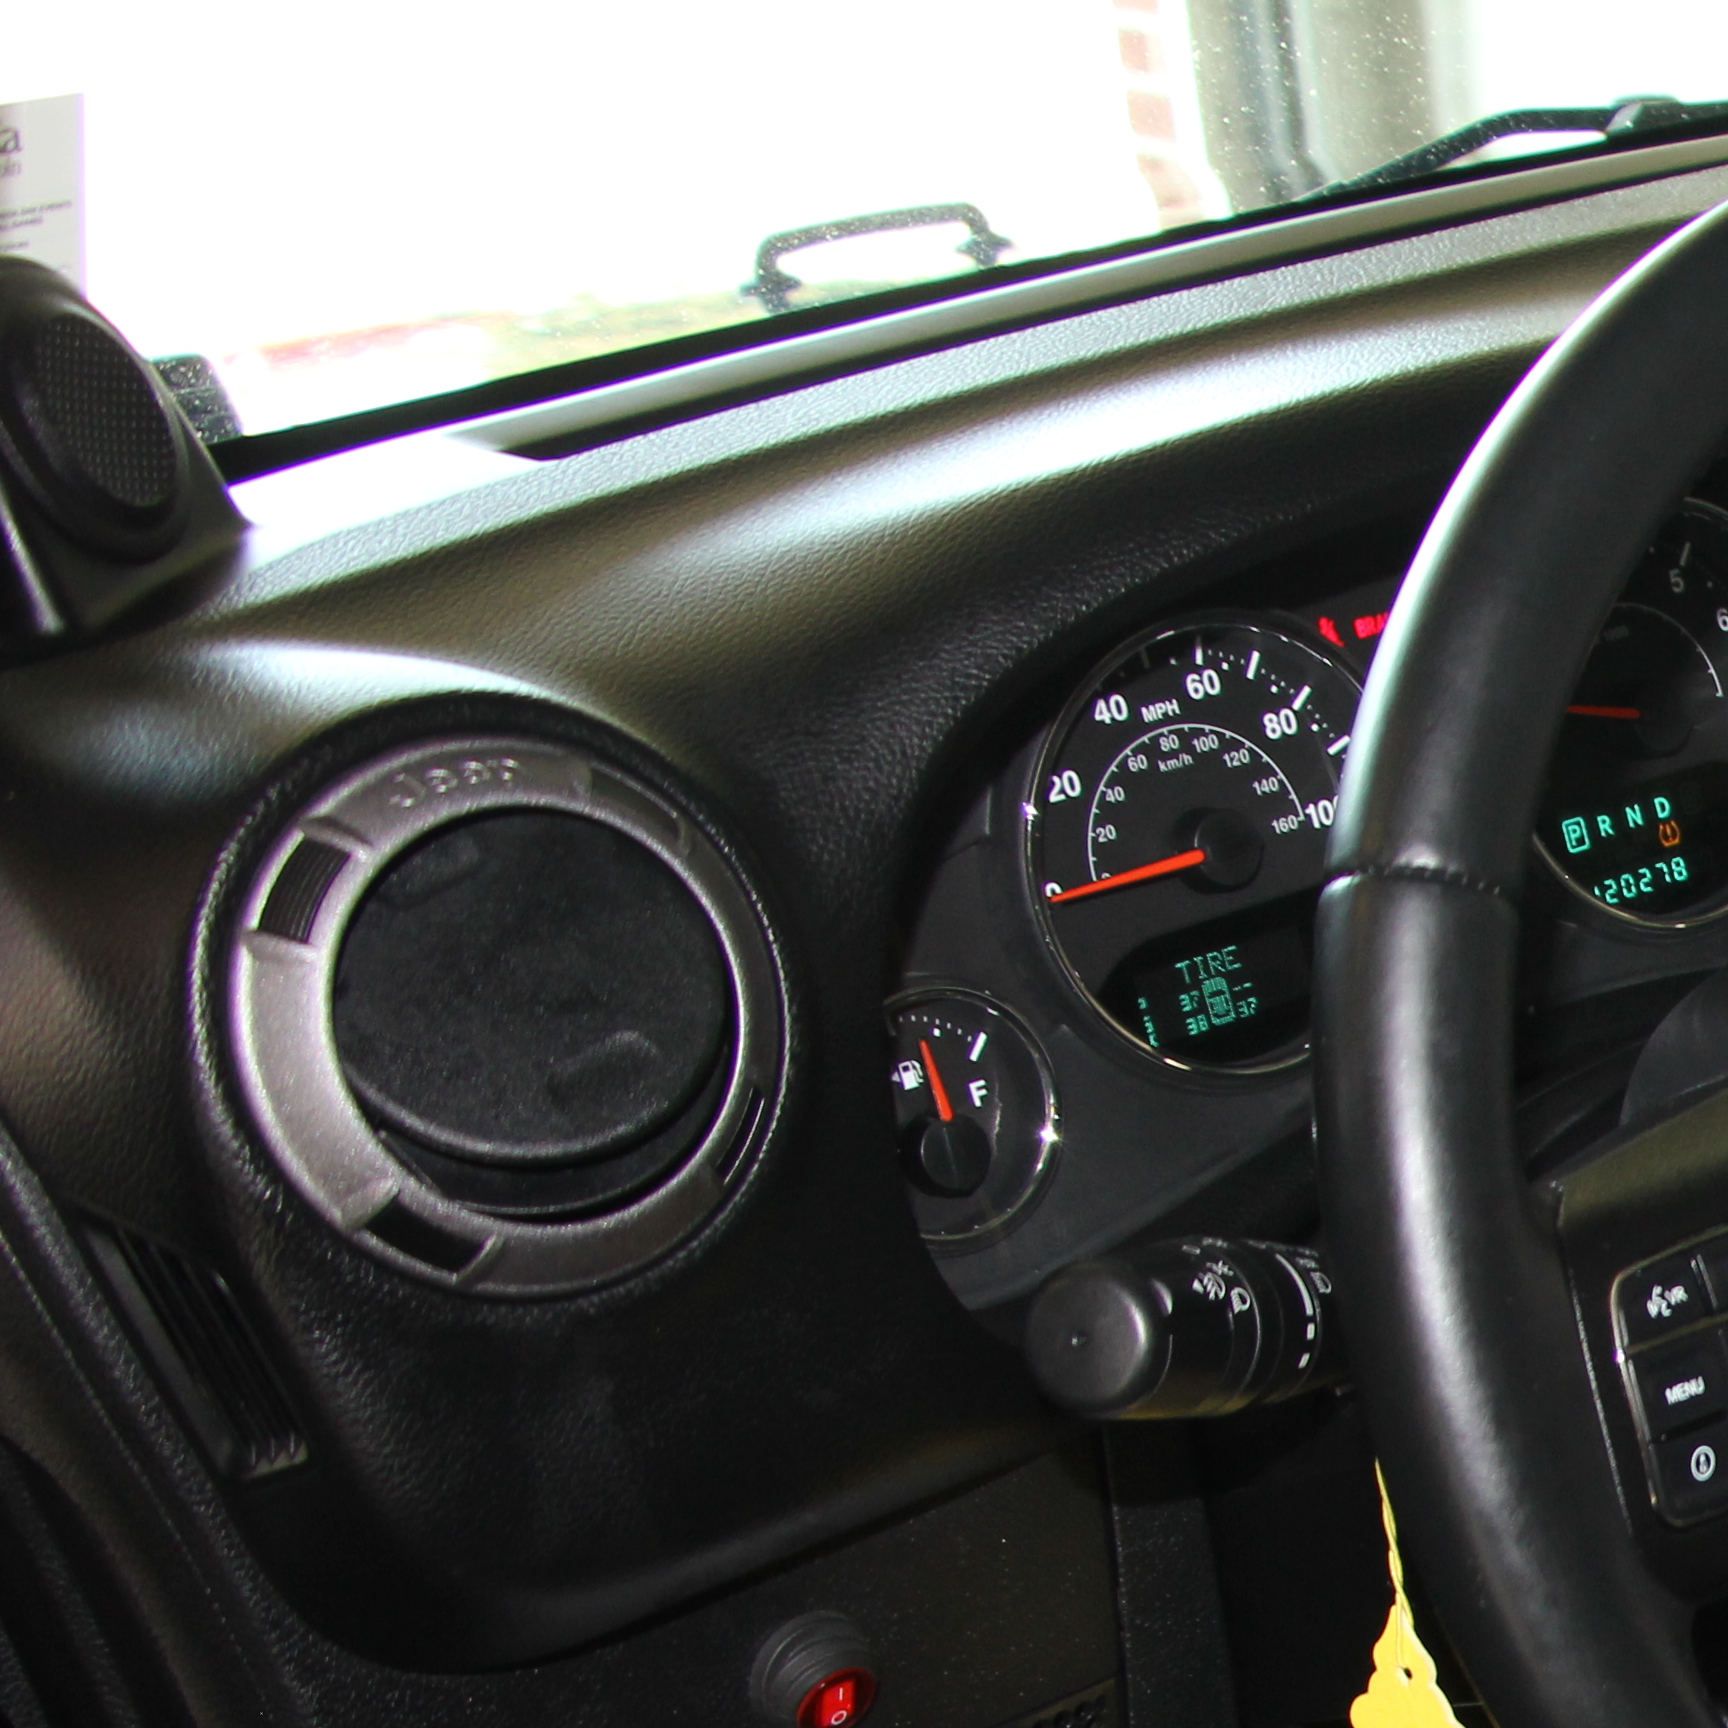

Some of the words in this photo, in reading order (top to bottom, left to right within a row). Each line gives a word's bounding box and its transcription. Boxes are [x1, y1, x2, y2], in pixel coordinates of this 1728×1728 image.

[1669, 569, 1684, 594] 5
[1185, 668, 1222, 701] 60
[1093, 694, 1129, 725] 40
[1140, 699, 1181, 723] MPH
[1263, 708, 1299, 740] 80
[1158, 733, 1181, 752] 80
[1191, 732, 1220, 753] 100
[1126, 753, 1149, 772] 60
[1156, 752, 1194, 773] km/h
[1222, 748, 1251, 768] 120
[1048, 769, 1083, 803] 20
[1104, 785, 1126, 804] 40
[1252, 776, 1280, 797] 140
[1271, 814, 1299, 835] 160
[1304, 795, 1339, 830] 10
[1596, 814, 1616, 838] R
[1624, 803, 1645, 829] N
[1653, 796, 1673, 819] D
[1096, 823, 1117, 844] 20
[1174, 945, 1242, 983] TIRE
[968, 1078, 989, 1108] F
[1664, 1376, 1706, 1405] MENU
